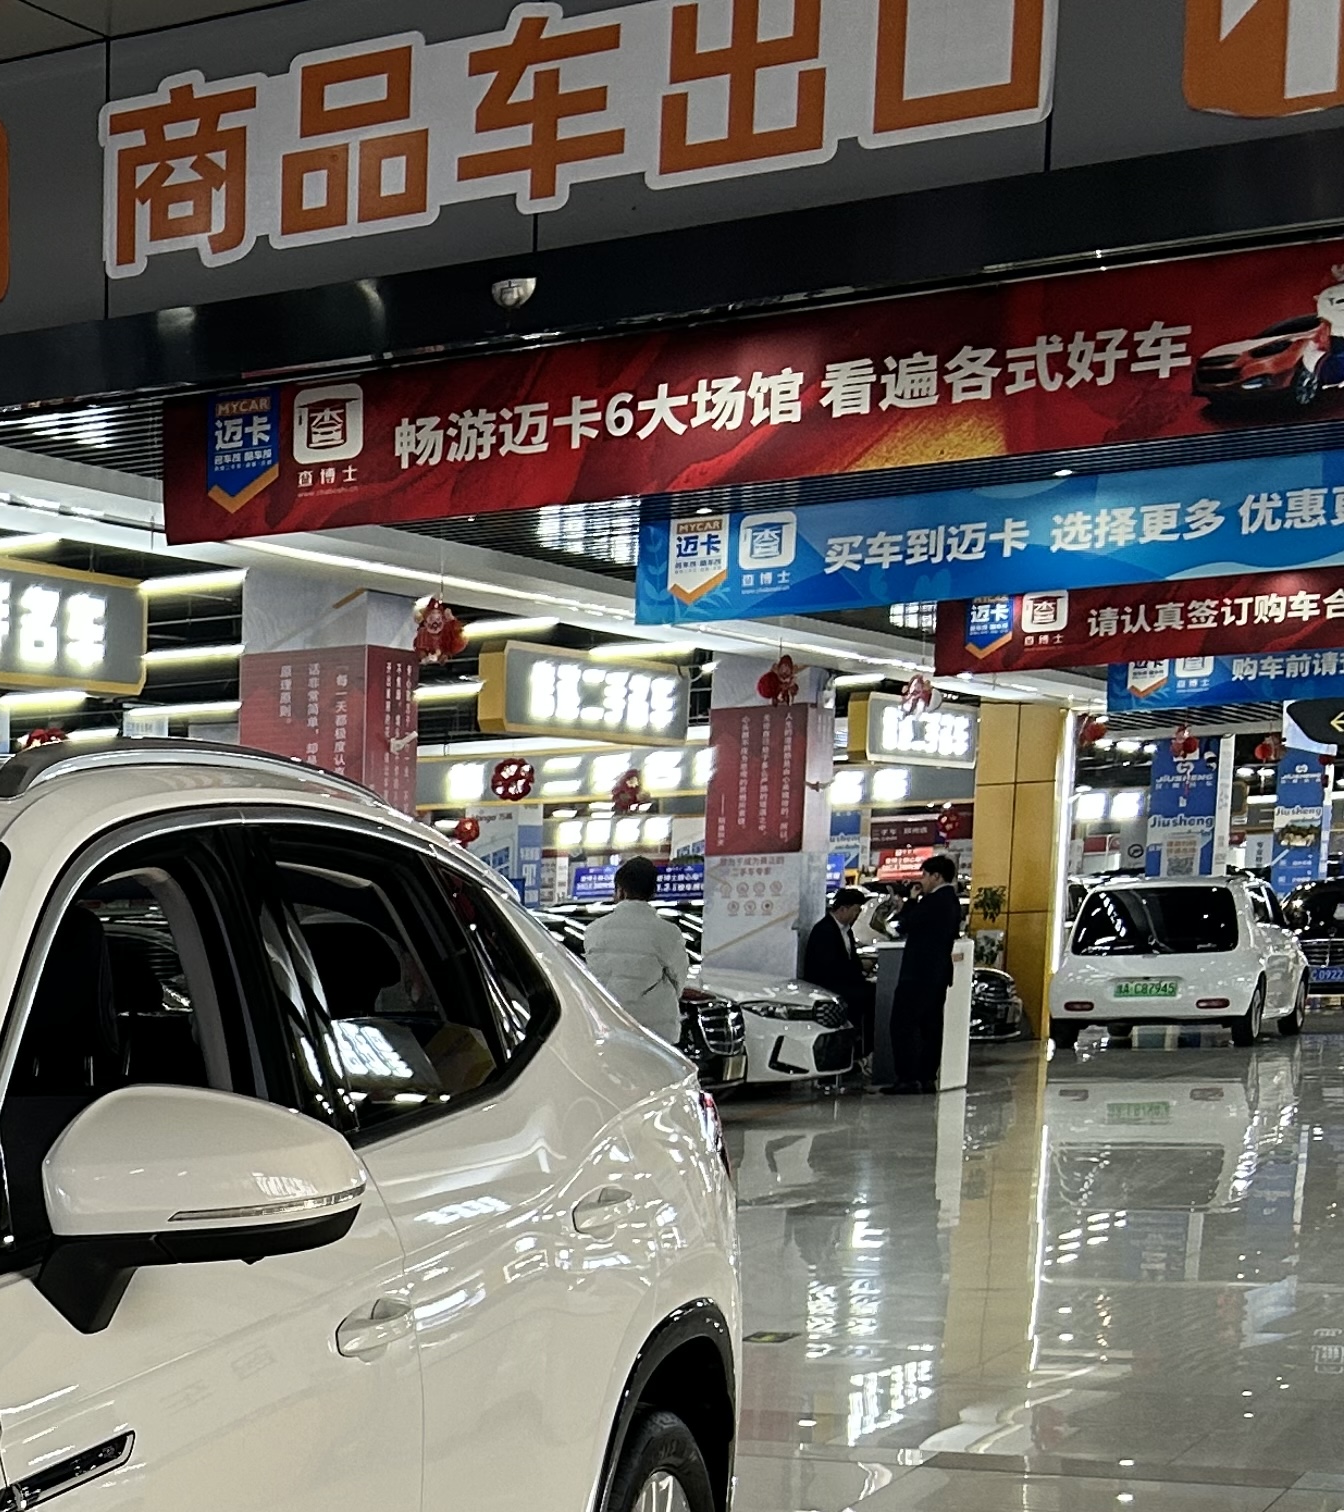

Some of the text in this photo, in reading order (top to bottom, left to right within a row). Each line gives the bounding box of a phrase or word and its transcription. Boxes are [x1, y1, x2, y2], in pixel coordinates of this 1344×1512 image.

[102, 0, 1057, 275] 商品车出口
[216, 397, 270, 417] MYCAR
[394, 321, 1192, 469] 畅游迈卡6大场馆 看遍各式好车
[214, 415, 271, 451] 迈卡
[297, 466, 358, 488] 查博士
[677, 519, 723, 534] MYCAR
[824, 518, 1030, 575] 买车到迈卡
[1051, 499, 1225, 554] 选择更多
[676, 534, 721, 558] 迈卡
[970, 604, 1009, 623] 迈卡
[1088, 590, 1344, 638] 请认真签订购车合
